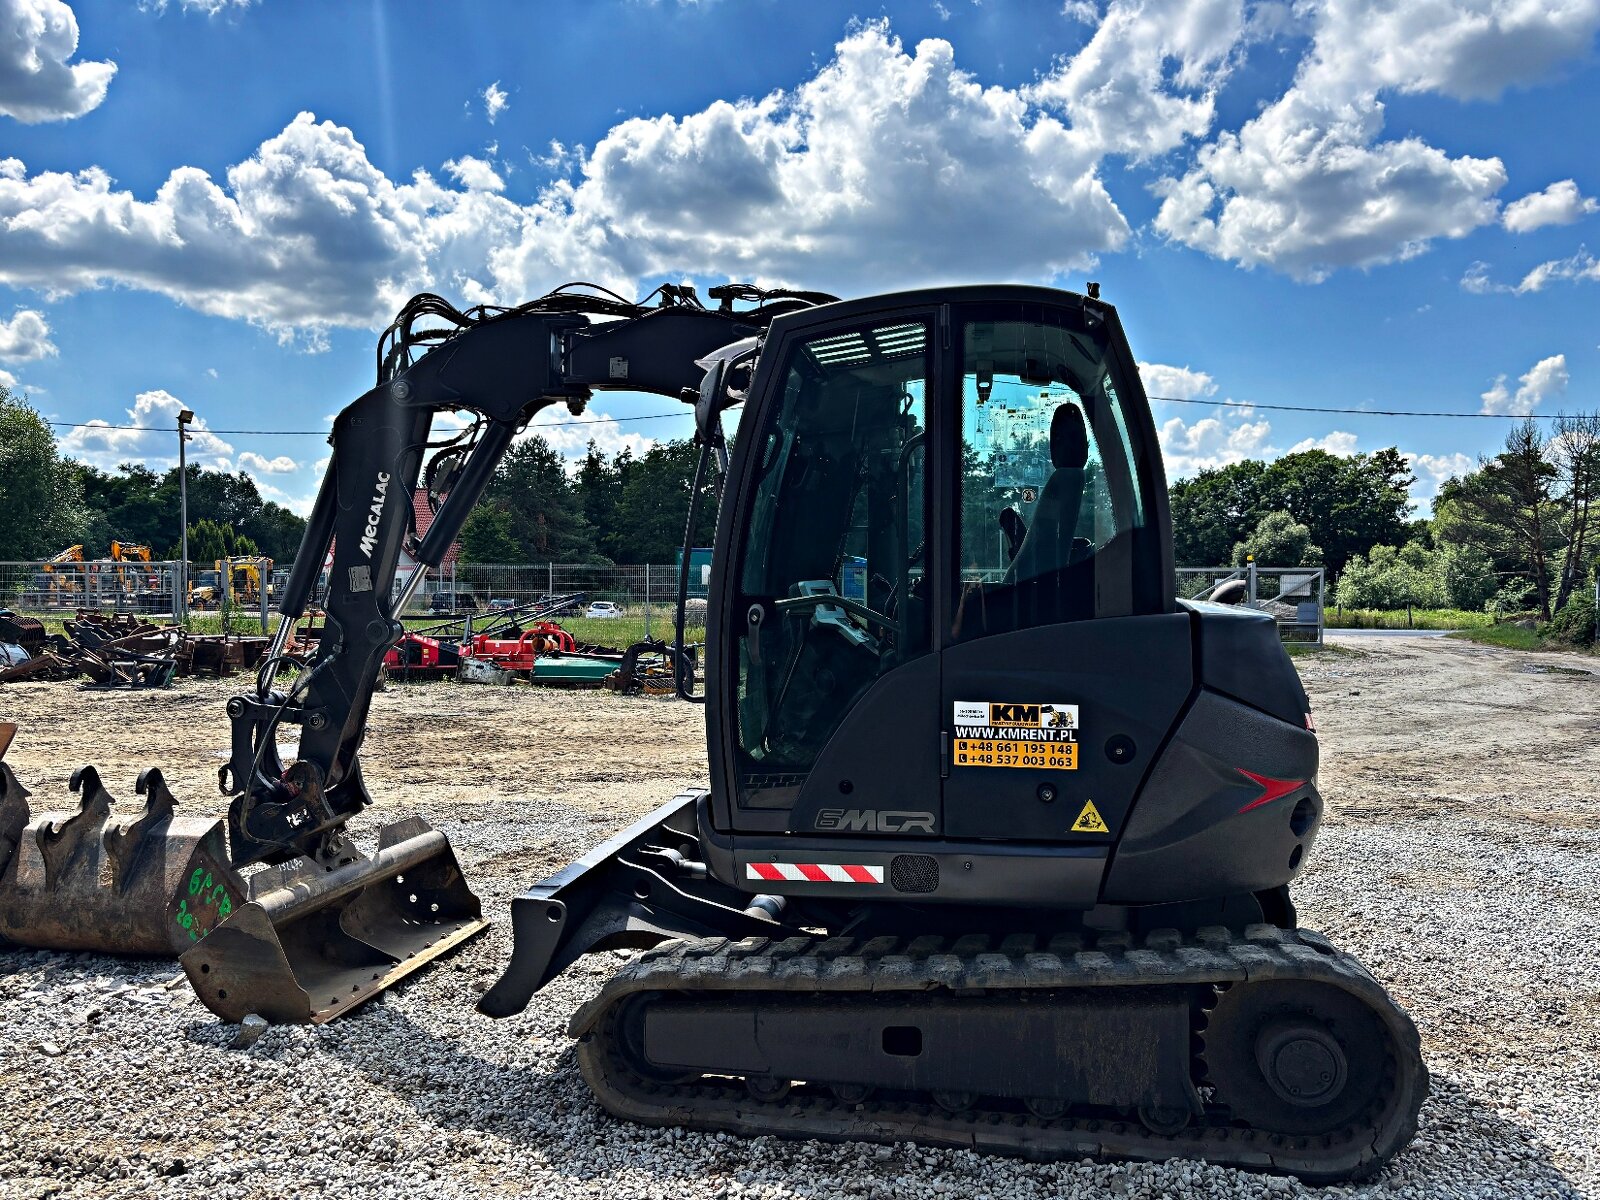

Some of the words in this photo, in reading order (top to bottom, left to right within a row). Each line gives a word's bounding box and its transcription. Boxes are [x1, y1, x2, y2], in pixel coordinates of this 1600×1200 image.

[992, 705, 1040, 722] KM
[955, 726, 1077, 742] WWW.KMRENT.PL
[970, 742, 993, 751] +48
[996, 742, 1018, 752] 661
[1023, 743, 1046, 753] 195
[1049, 744, 1072, 754] 148
[970, 754, 993, 764] +48
[996, 755, 1019, 765] 537
[1022, 755, 1046, 766] 003
[1049, 756, 1072, 767] 063
[814, 808, 936, 833] 6MCR
